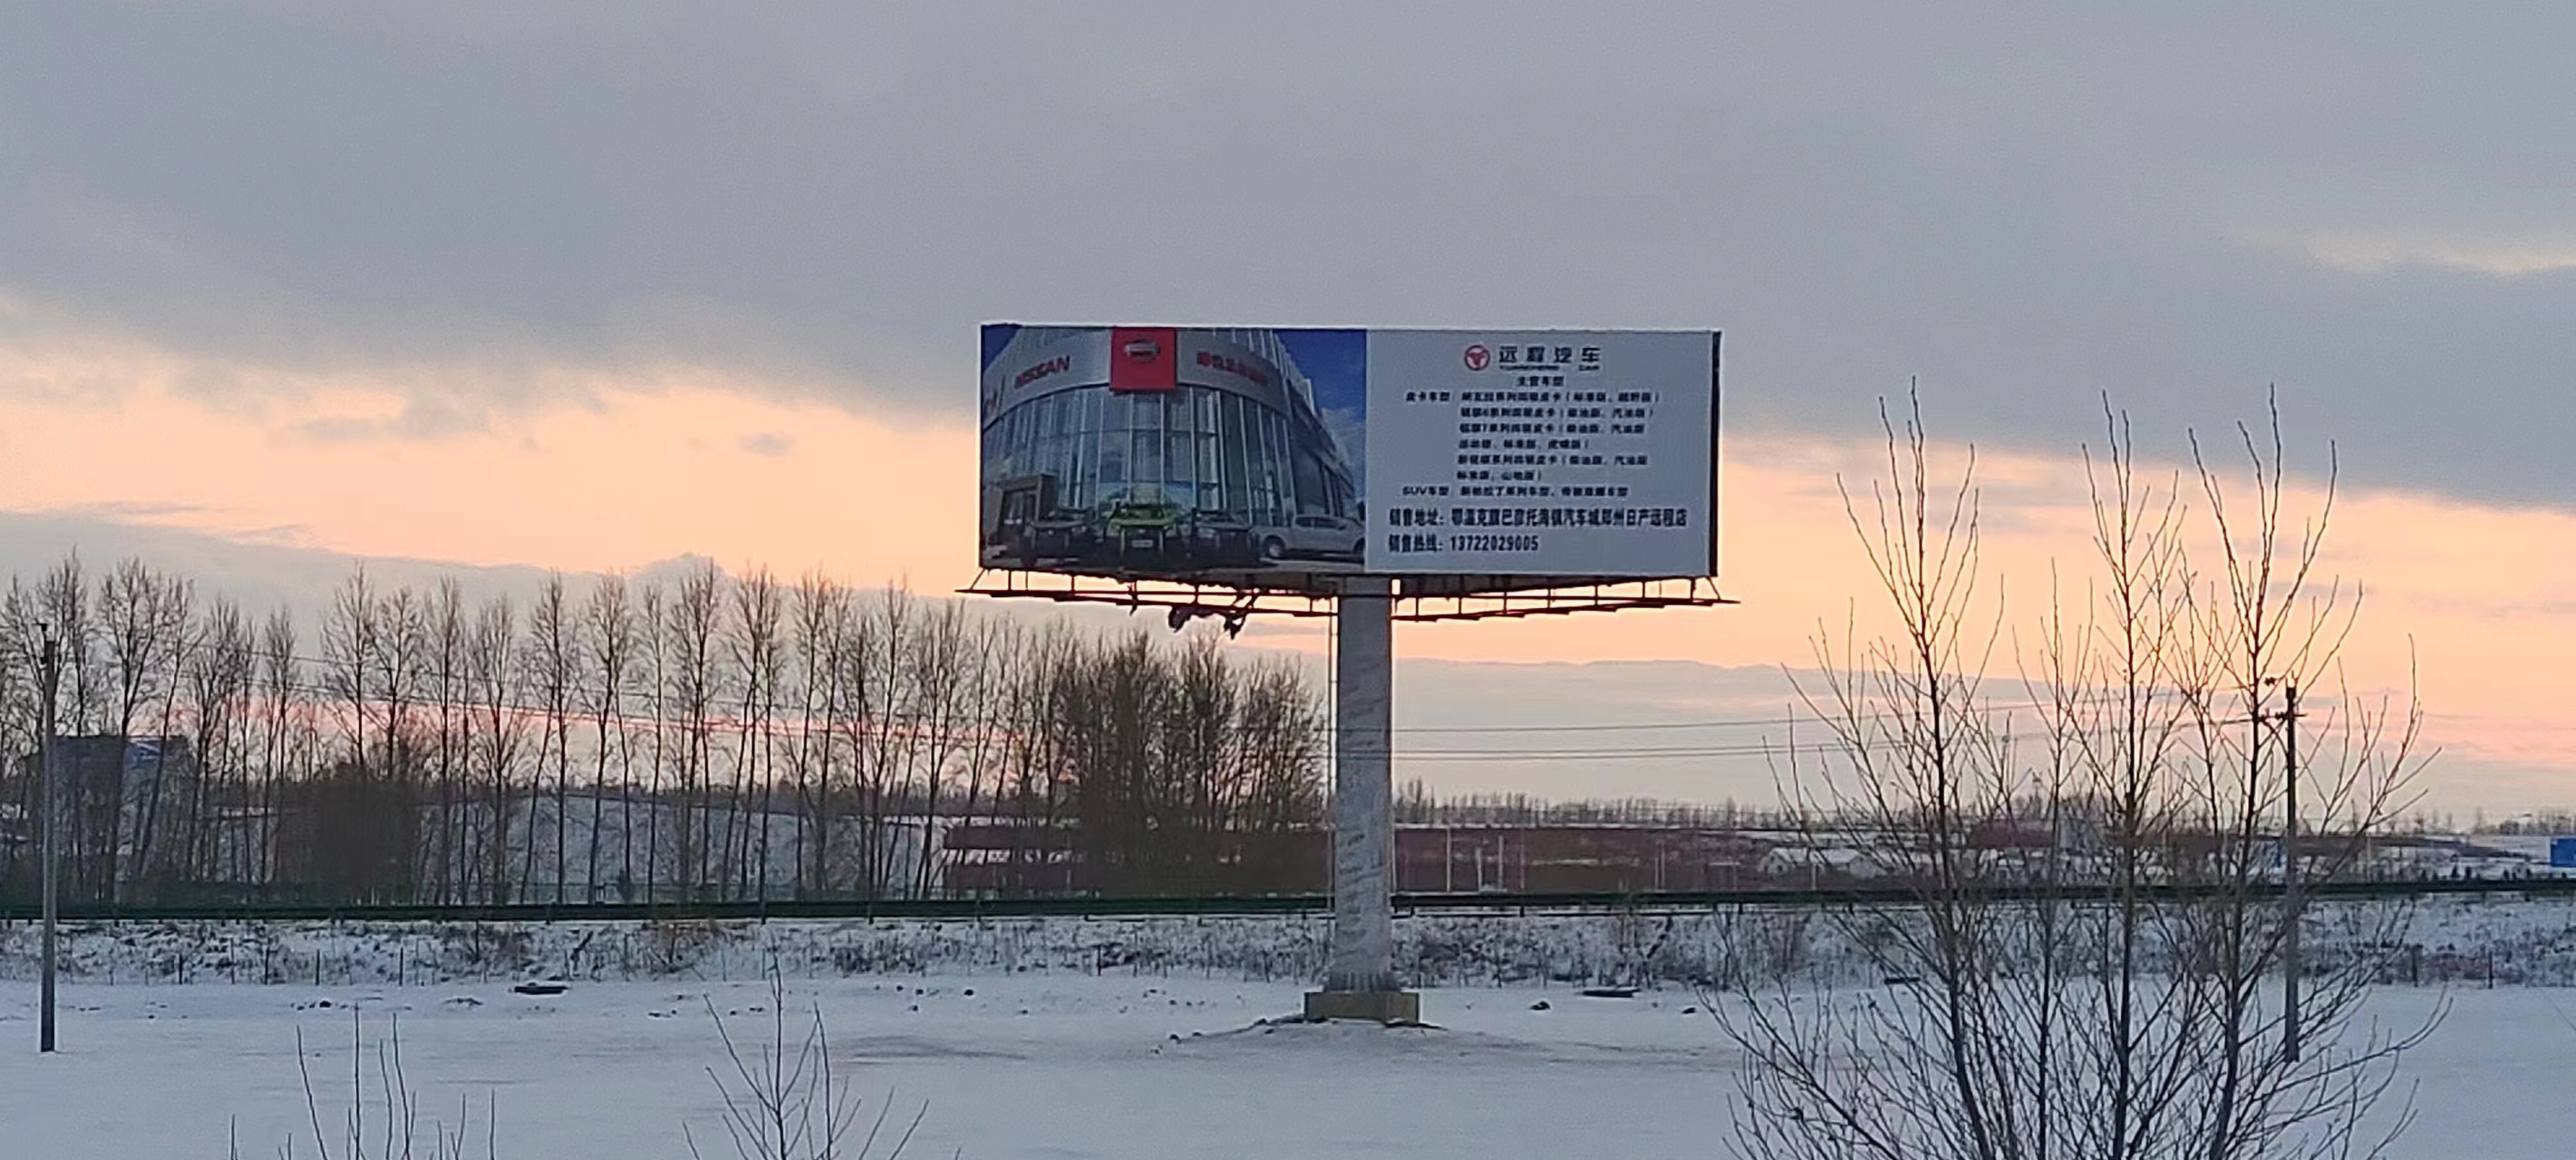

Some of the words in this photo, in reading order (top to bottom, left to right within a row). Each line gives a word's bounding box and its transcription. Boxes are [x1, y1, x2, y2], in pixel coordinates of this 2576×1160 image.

[1499, 346, 1600, 363] 远程汽车
[1518, 376, 1564, 386] 主营车型
[1406, 392, 1449, 401] 皮卡车型
[1403, 487, 1448, 496] SUV车型
[1451, 536, 1538, 551] 13722029005
